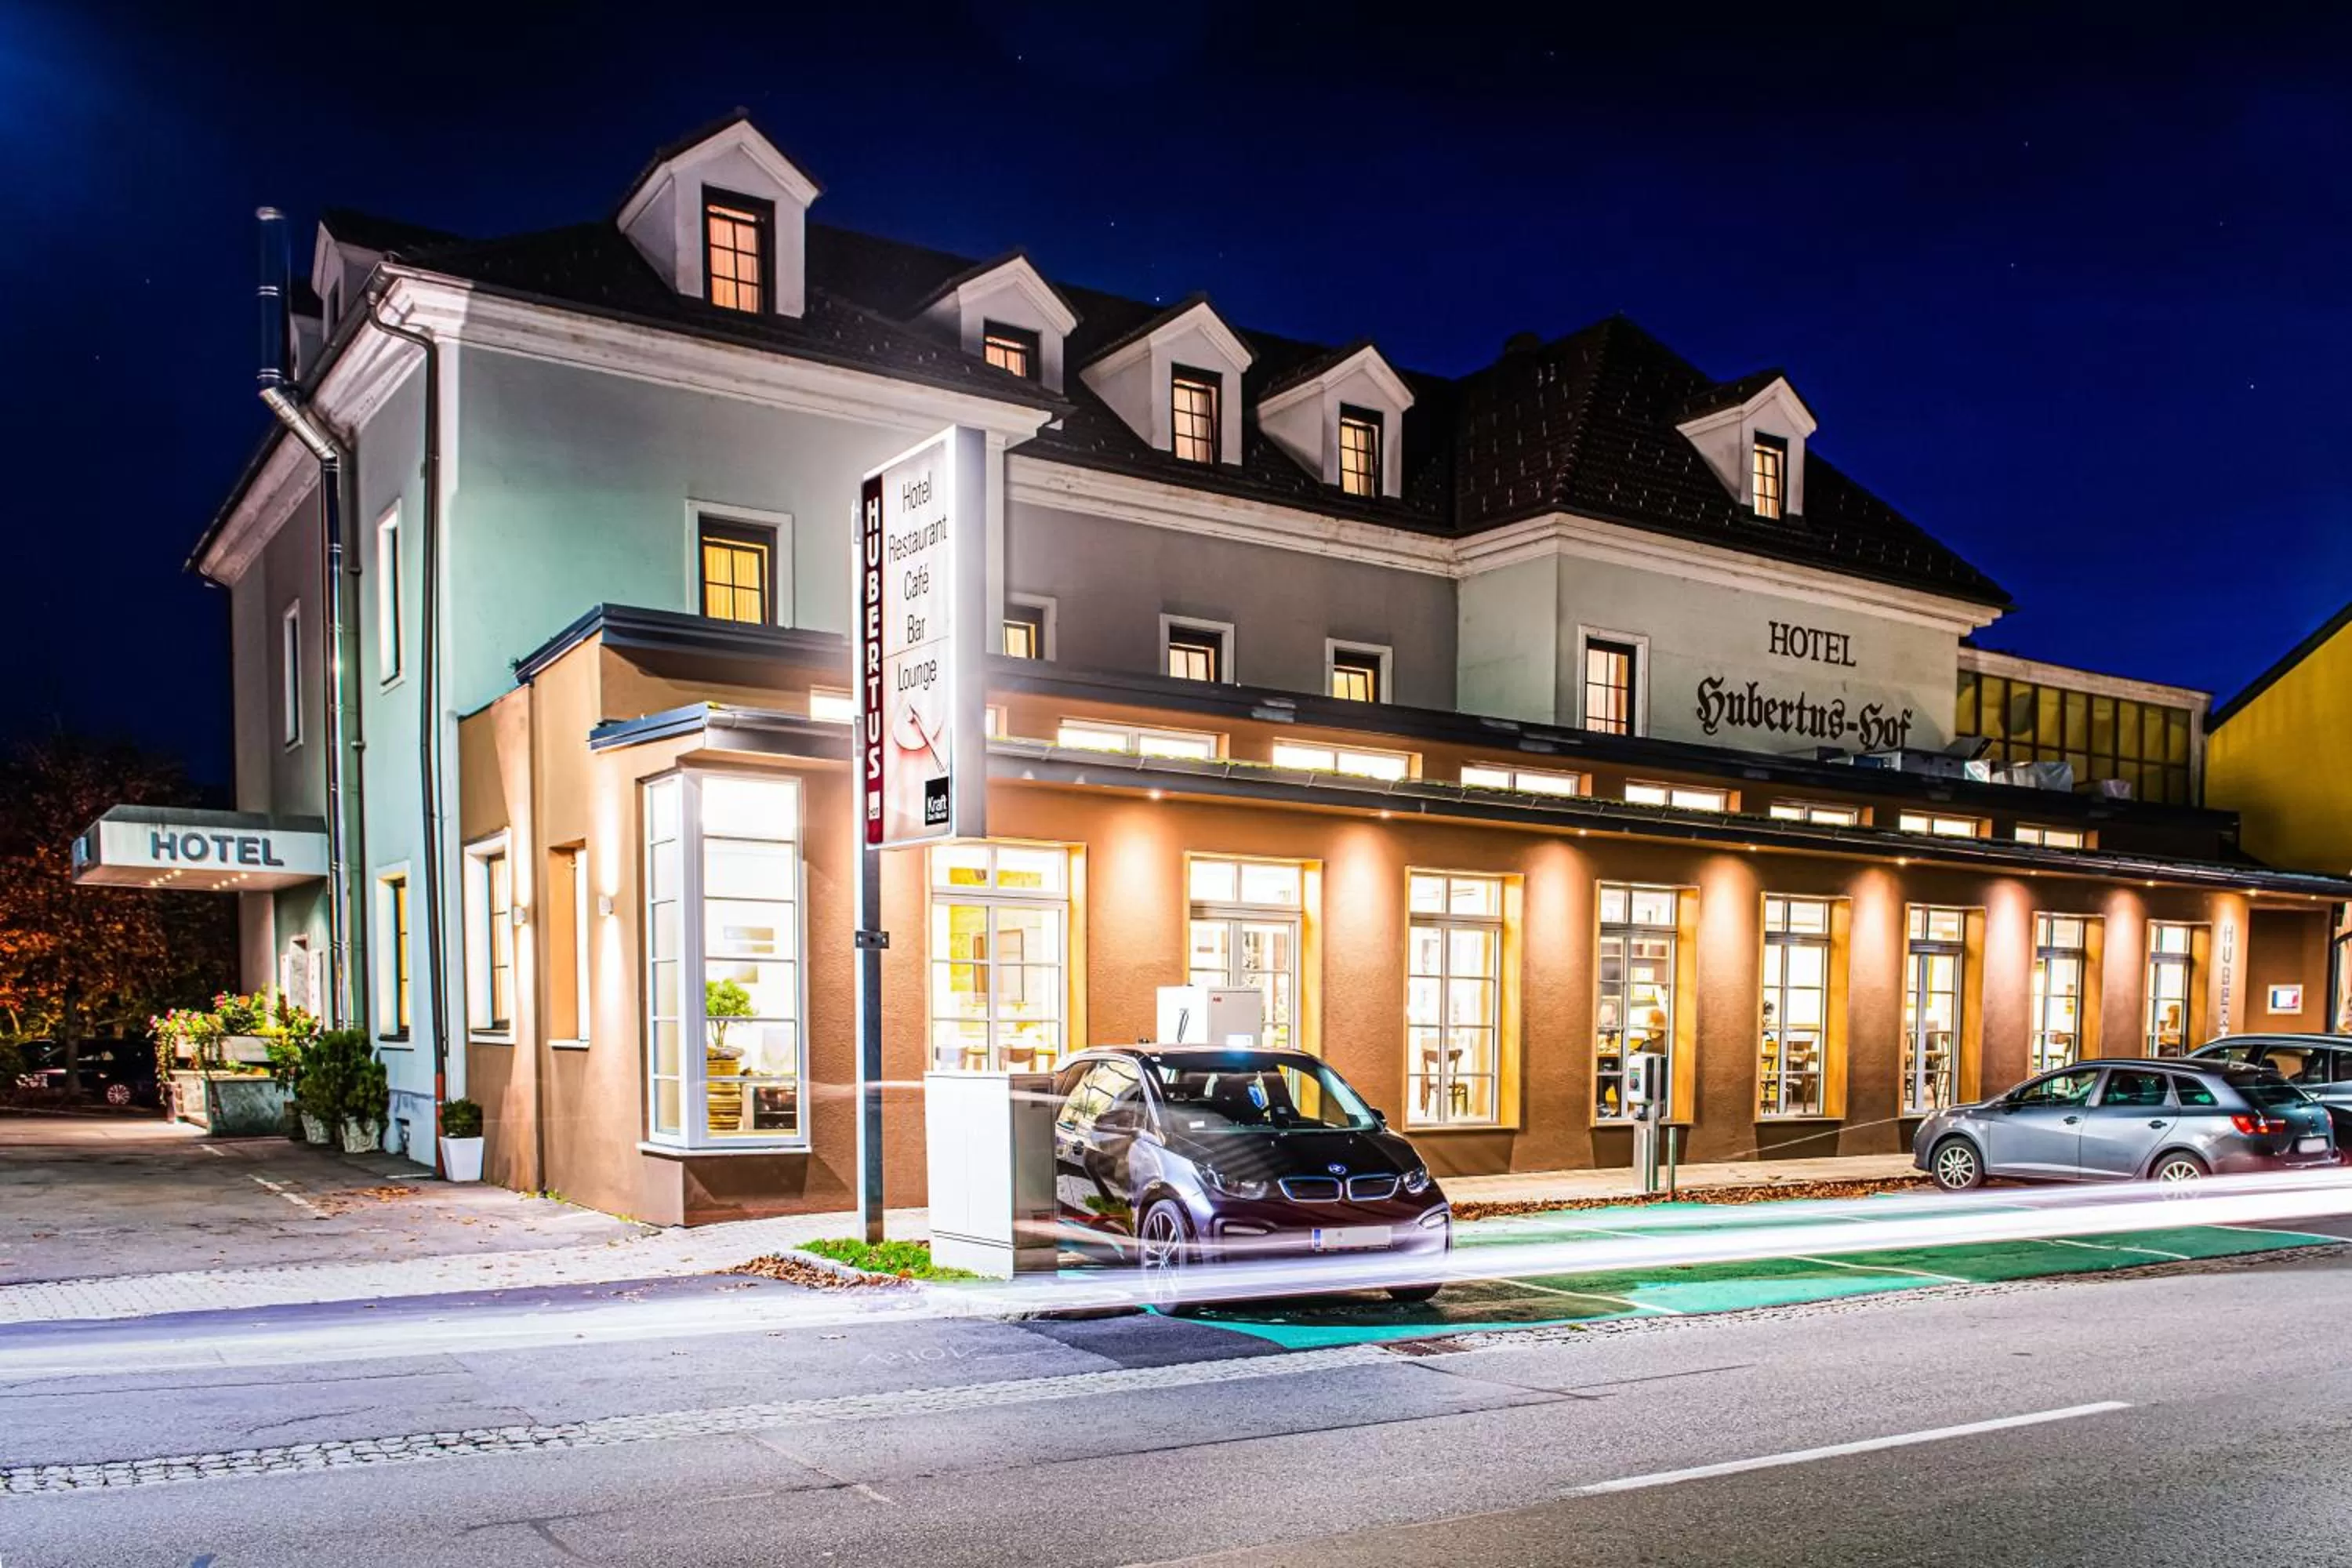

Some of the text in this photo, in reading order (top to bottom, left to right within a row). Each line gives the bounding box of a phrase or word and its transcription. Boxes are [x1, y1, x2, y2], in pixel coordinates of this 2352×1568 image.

[902, 471, 931, 513] Hotel
[888, 514, 947, 564] Restaurant
[904, 562, 929, 601] Café
[866, 496, 880, 780] HUBERTUS
[907, 614, 926, 644] Bar
[1768, 620, 1857, 667] HOTEL
[898, 659, 937, 691] Lounge
[1696, 677, 1913, 751] Hubertus-Hof
[150, 832, 285, 866] HOTEL
